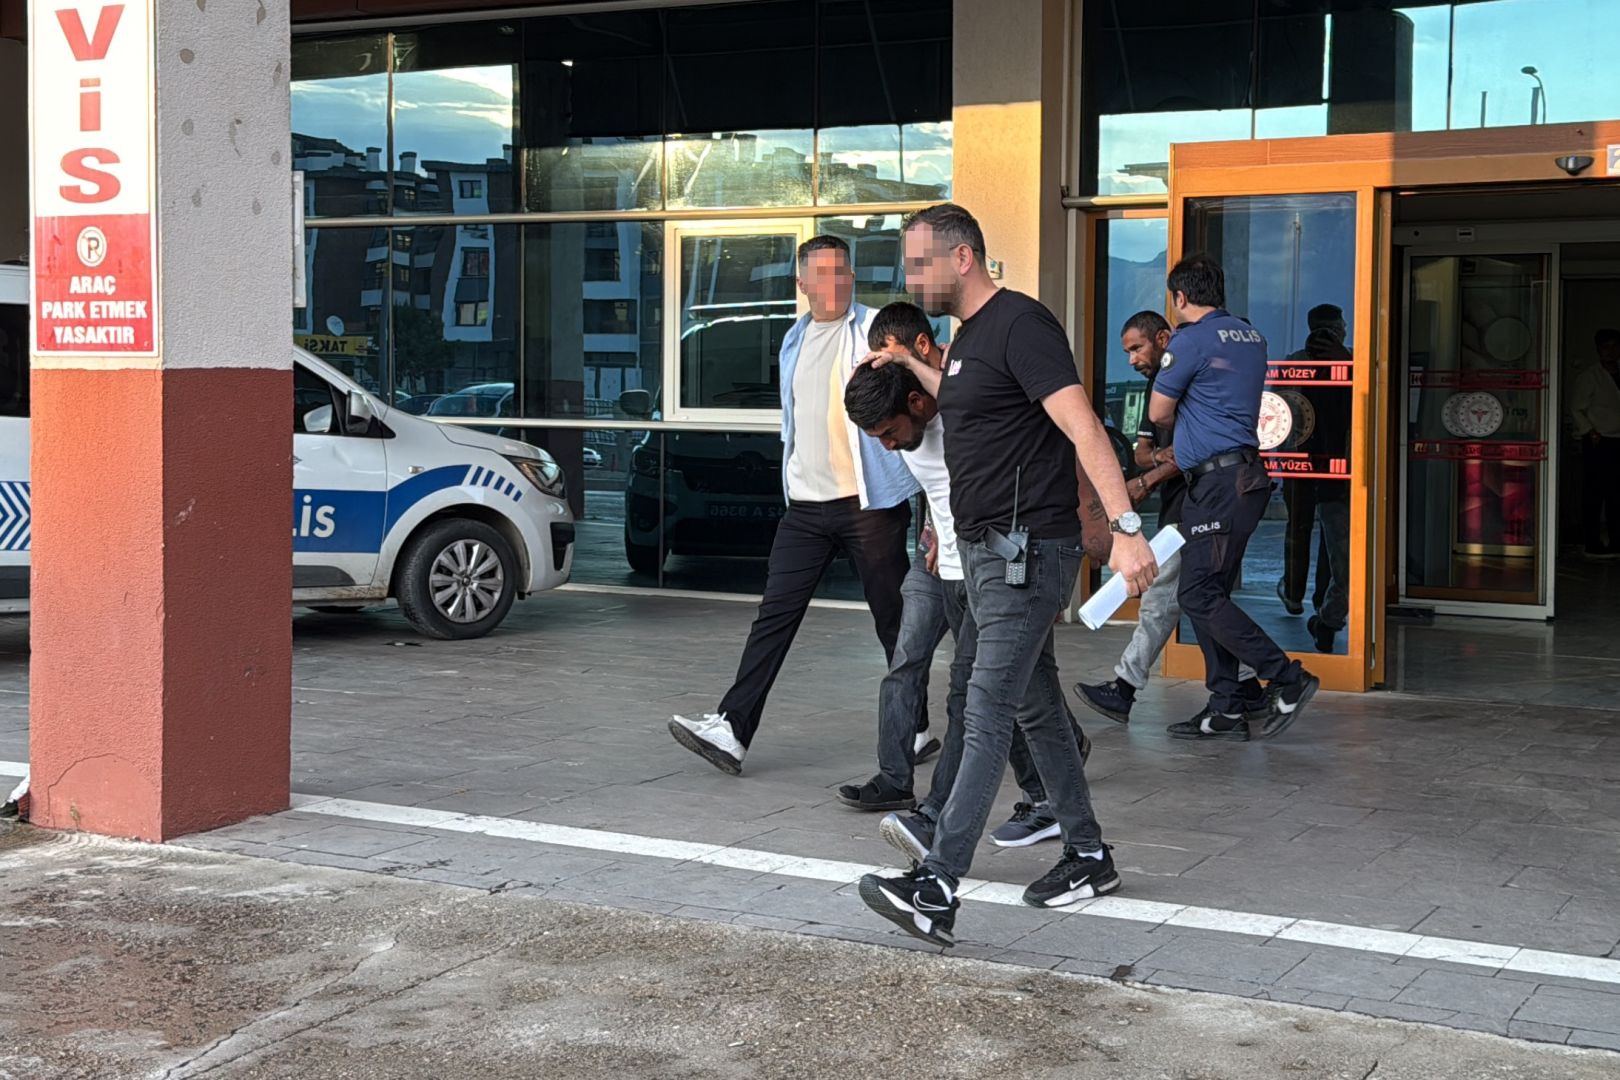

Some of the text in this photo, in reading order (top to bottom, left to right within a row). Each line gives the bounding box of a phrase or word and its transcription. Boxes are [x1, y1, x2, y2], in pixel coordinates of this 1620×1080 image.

[69, 275, 116, 295] ARAÇ
[41, 301, 147, 319] PARK ETMEK
[53, 326, 135, 344] YASAKTIR
[1281, 367, 1316, 379] YÜZEY
